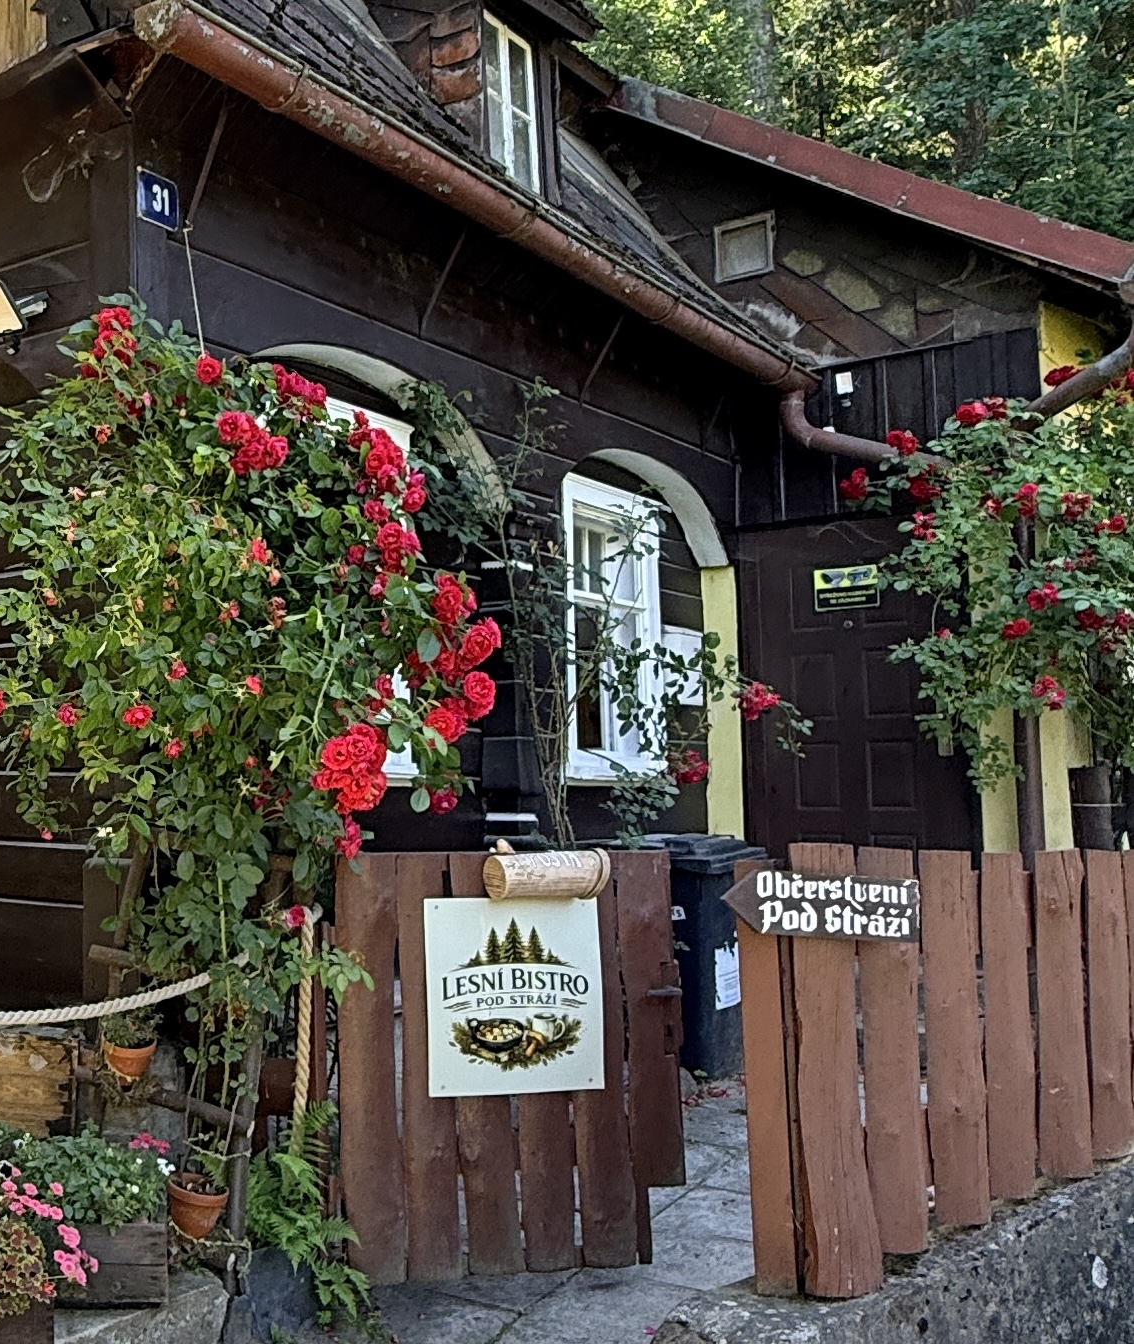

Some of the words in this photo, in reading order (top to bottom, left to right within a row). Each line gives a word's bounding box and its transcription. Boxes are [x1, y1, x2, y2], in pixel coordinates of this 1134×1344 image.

[152, 184, 170, 217] 31
[756, 870, 913, 910] Občerstvení
[758, 900, 817, 934] Pod
[825, 904, 913, 938] Stráží
[441, 967, 504, 1001] LESNÍ
[511, 968, 589, 996] BISTRO
[476, 995, 504, 1007] POD
[509, 994, 557, 1006] STRÁŽÍ
